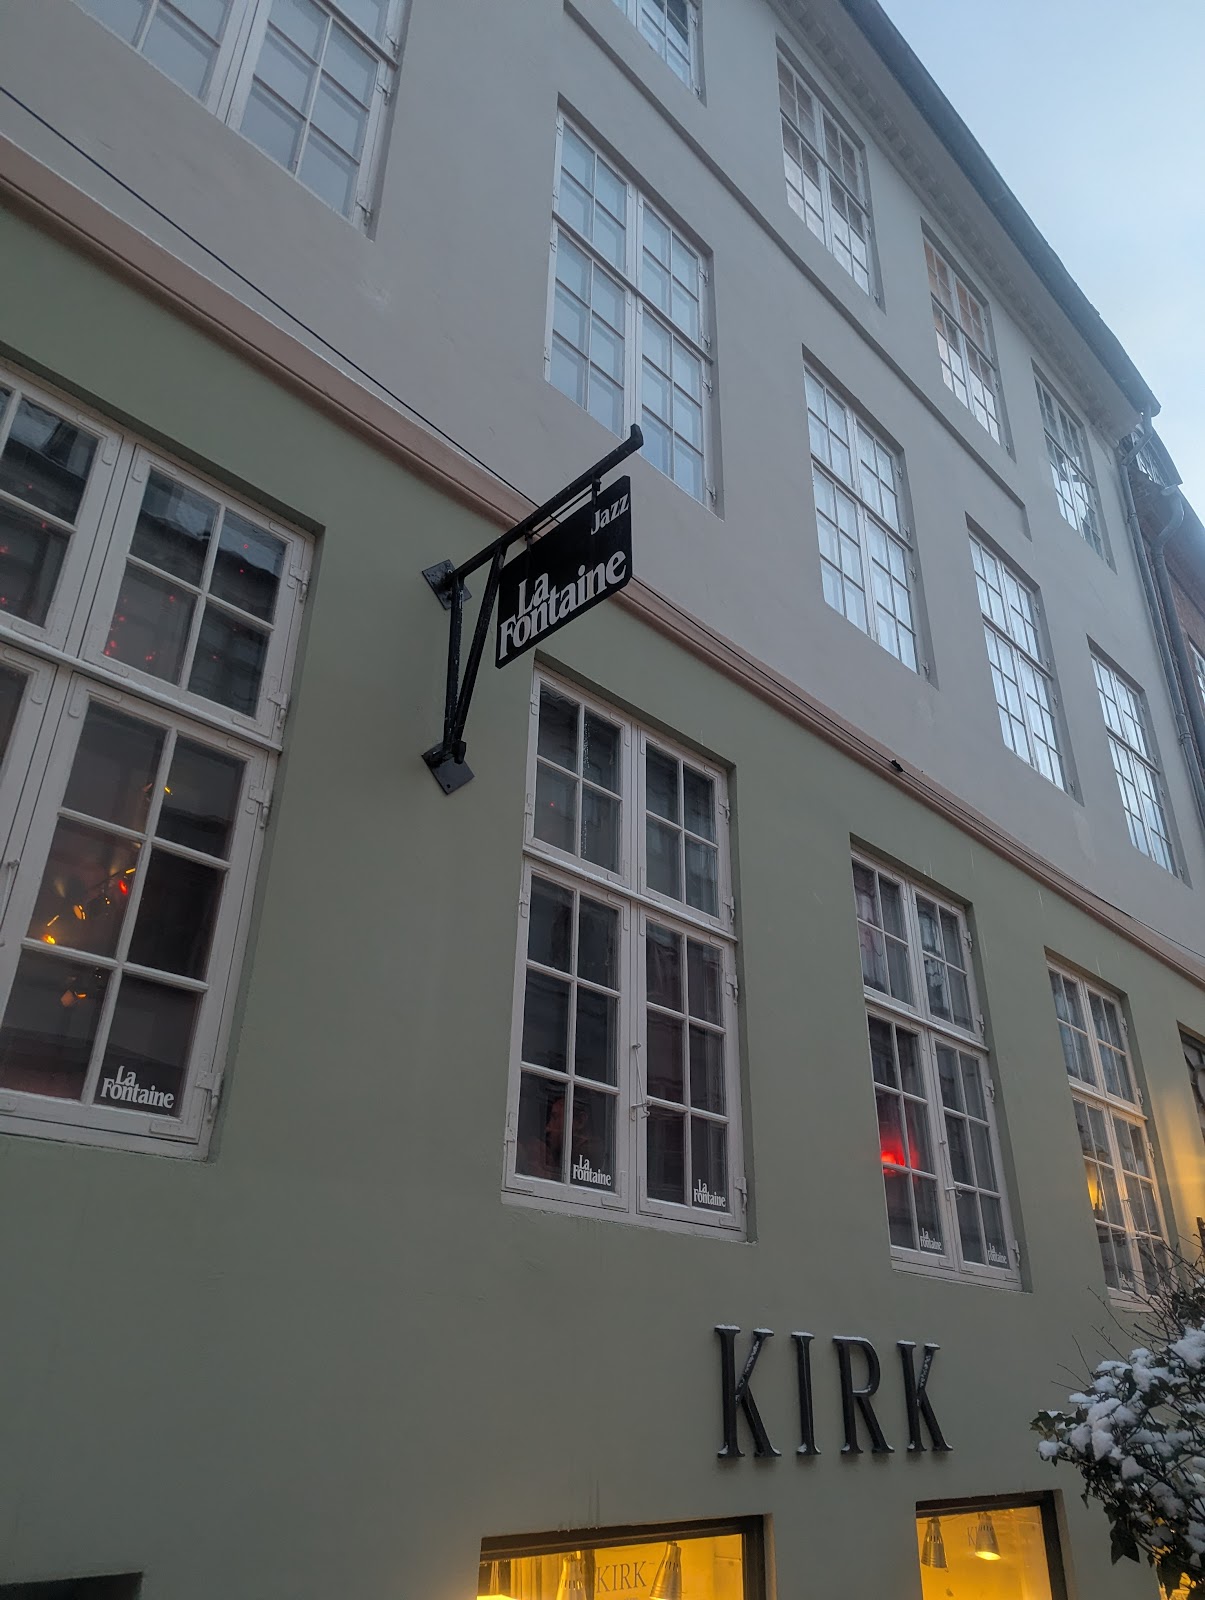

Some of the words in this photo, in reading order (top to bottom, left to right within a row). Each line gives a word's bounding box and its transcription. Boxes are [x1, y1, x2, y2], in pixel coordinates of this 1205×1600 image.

[590, 493, 630, 536] Jazz
[498, 550, 627, 661] Fontaine
[517, 572, 551, 620] La
[115, 1065, 137, 1087] La
[100, 1077, 175, 1109] Fontaine
[572, 1164, 612, 1187] Fontaine
[578, 1154, 590, 1171] La
[693, 1188, 727, 1208] Fontaine
[697, 1179, 708, 1194] La
[713, 1323, 954, 1458] KIRK
[595, 1560, 647, 1594] KIRK
